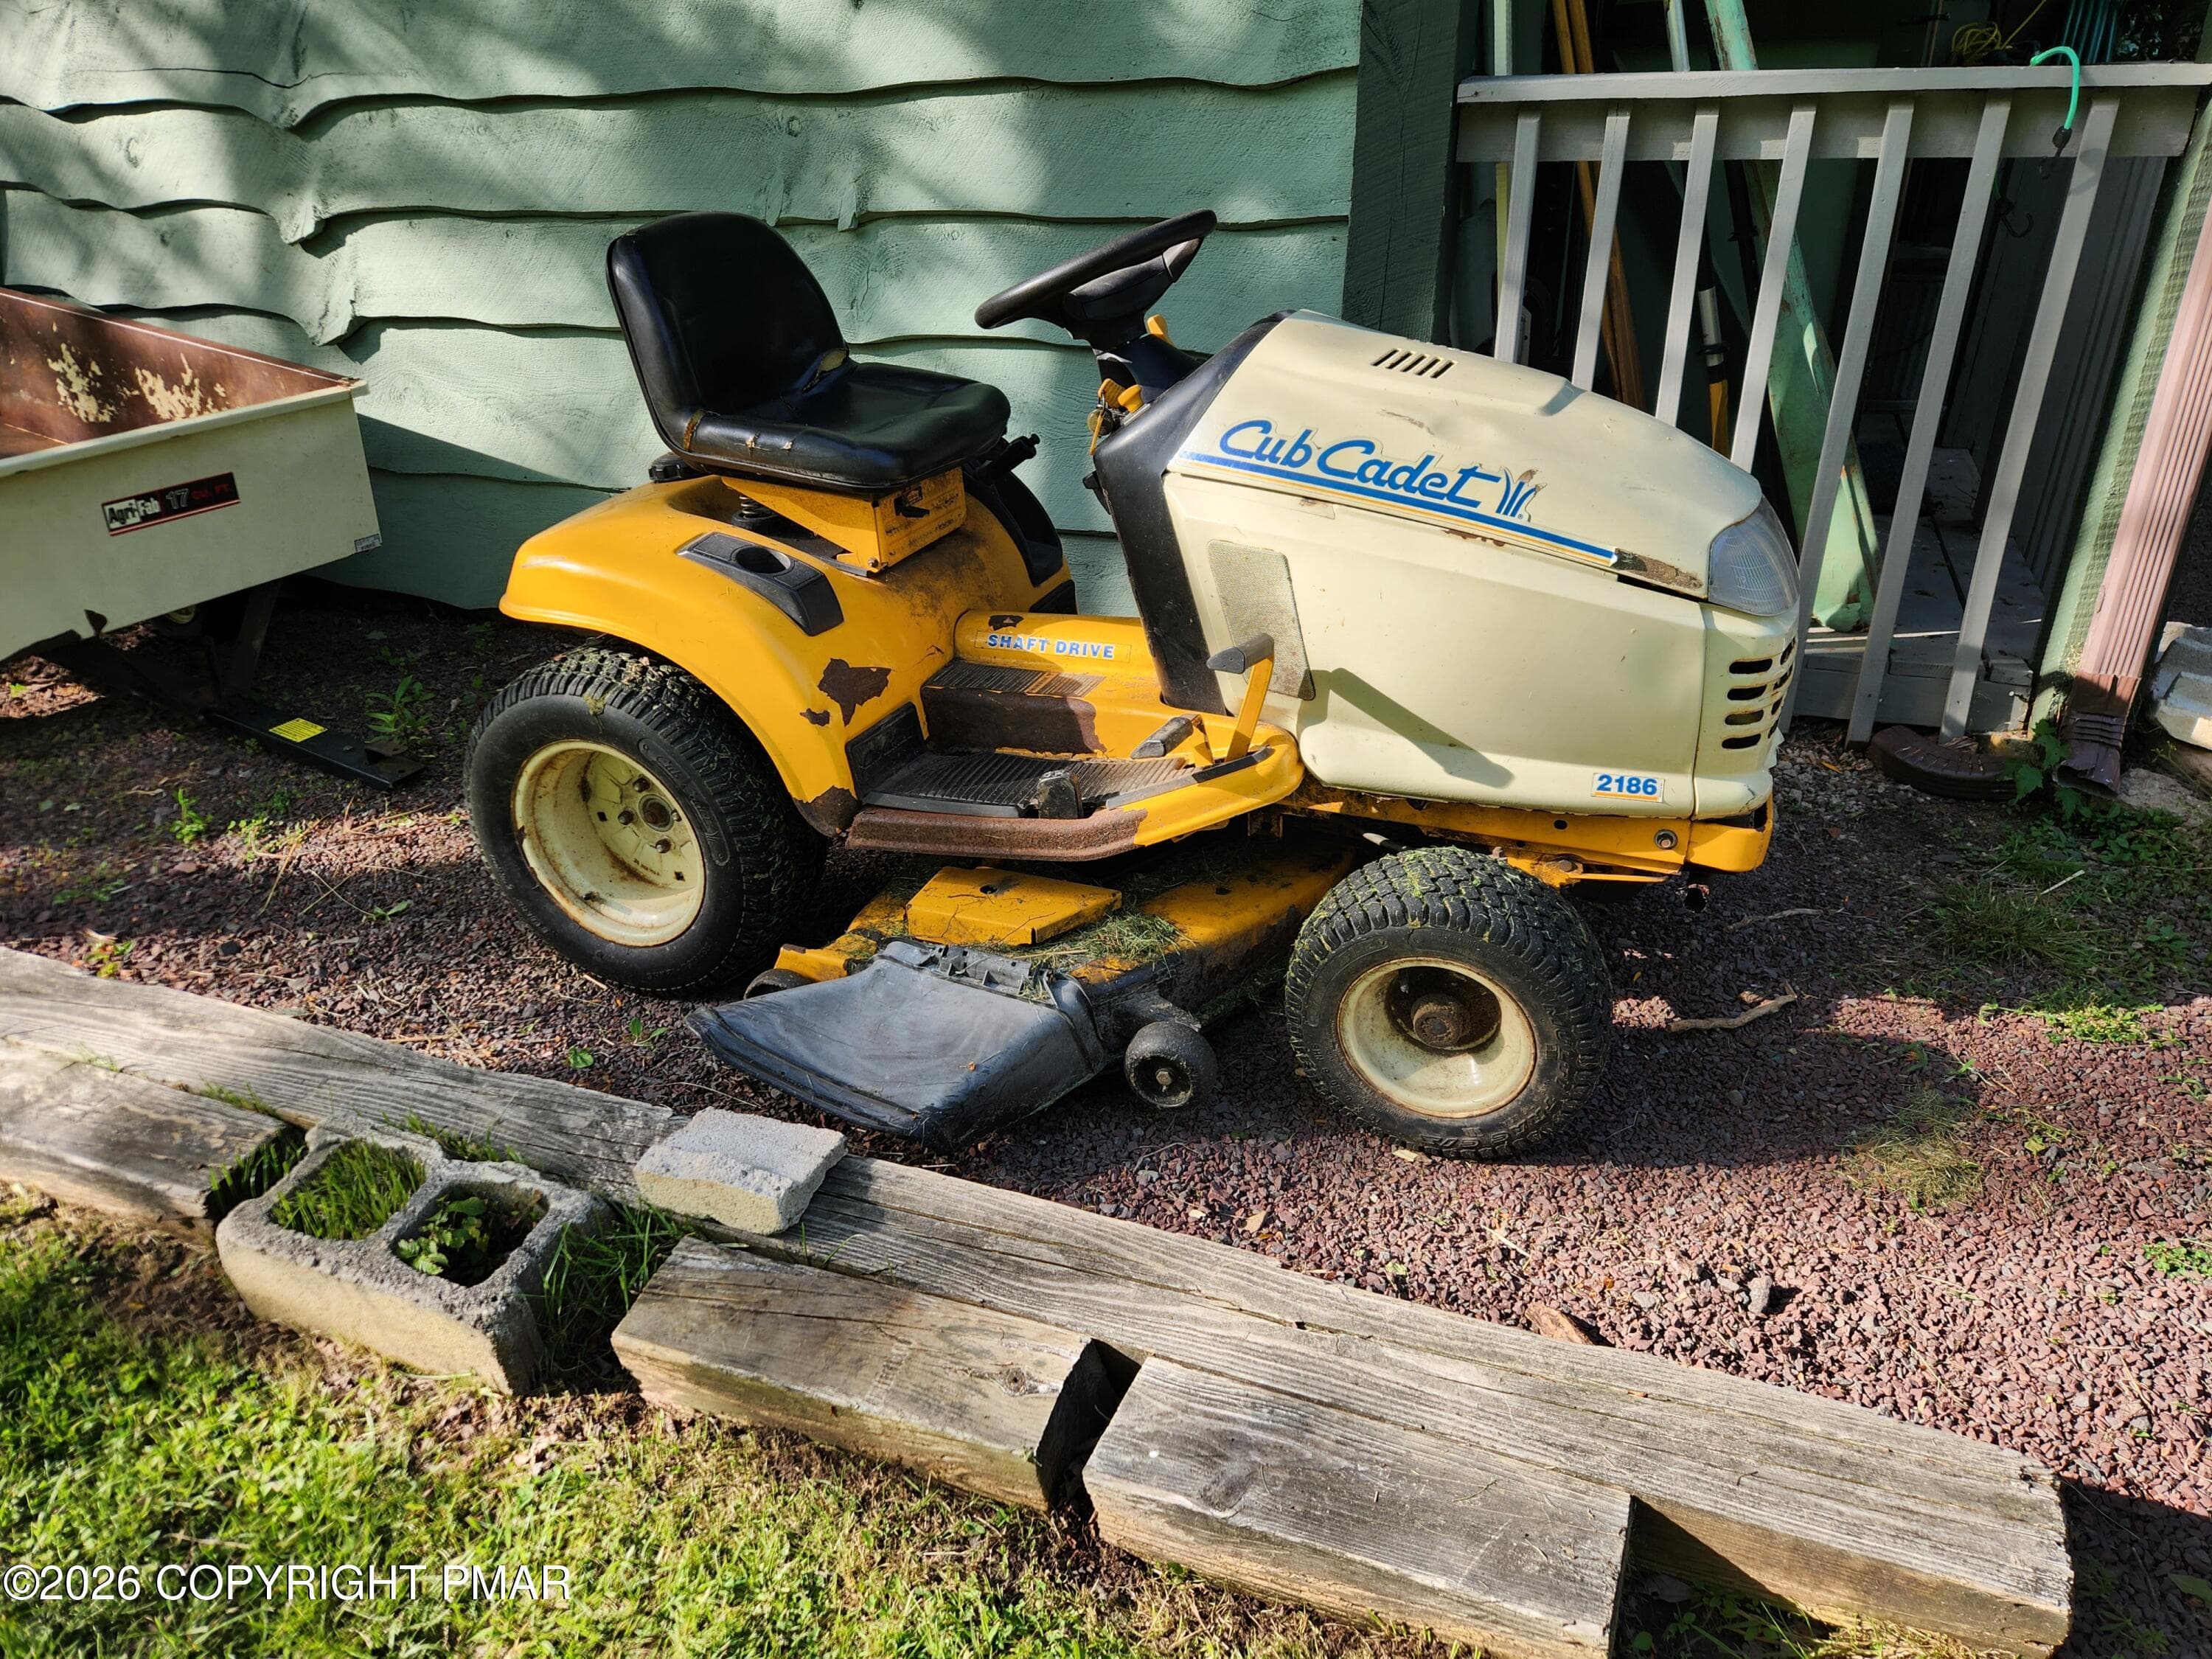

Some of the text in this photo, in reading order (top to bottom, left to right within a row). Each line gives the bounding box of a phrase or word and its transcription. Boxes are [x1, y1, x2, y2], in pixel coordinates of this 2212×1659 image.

[1220, 419, 1500, 508] Cub Cadet
[166, 487, 190, 509] 17
[987, 634, 1115, 659] SHAFT DRIVE
[1596, 774, 1658, 796] 2186
